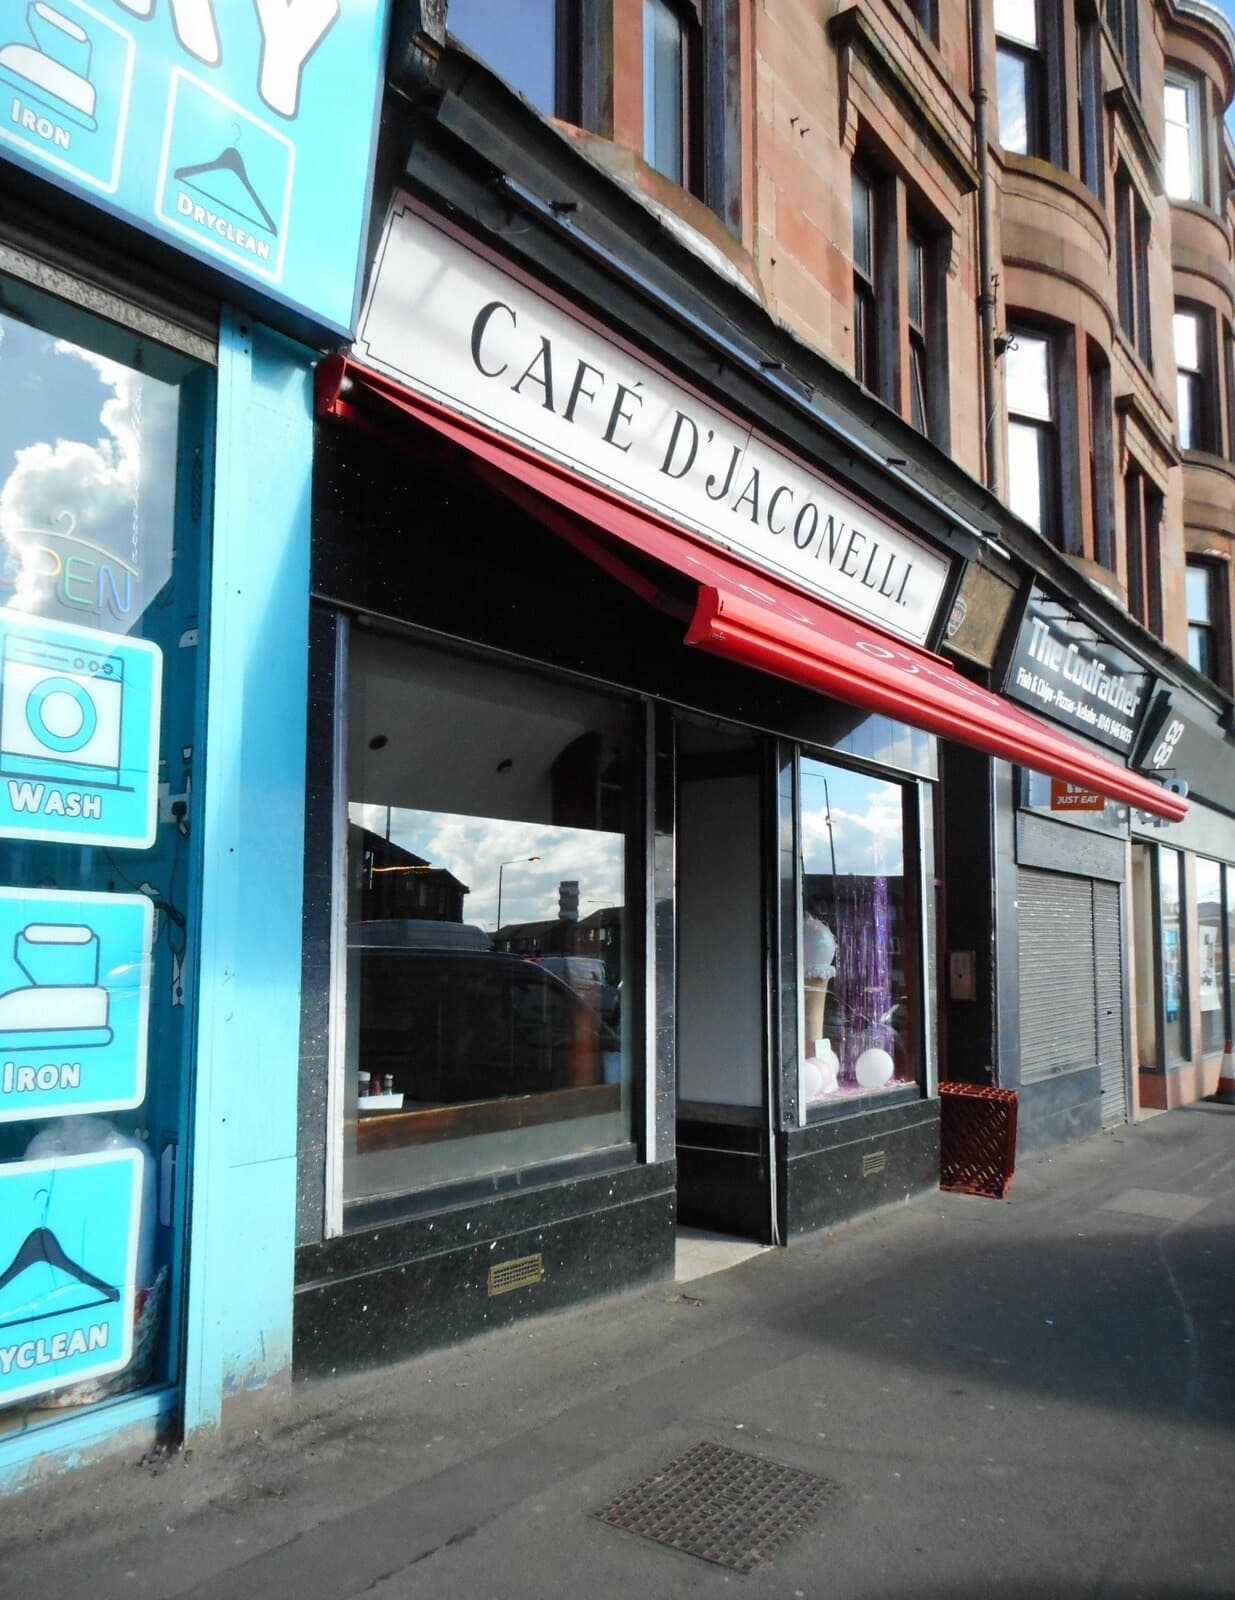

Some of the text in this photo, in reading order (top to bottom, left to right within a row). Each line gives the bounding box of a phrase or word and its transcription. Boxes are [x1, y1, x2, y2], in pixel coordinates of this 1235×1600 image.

[10, 98, 72, 151] IRON
[176, 191, 271, 261] DRYCLEAN
[469, 300, 645, 455] CAFÉ
[1028, 616, 1060, 672] The
[1063, 643, 1141, 717] Codfather
[8, 780, 102, 820] WASH
[1056, 795, 1098, 804] JUST EAT
[3, 1061, 80, 1093] IRON
